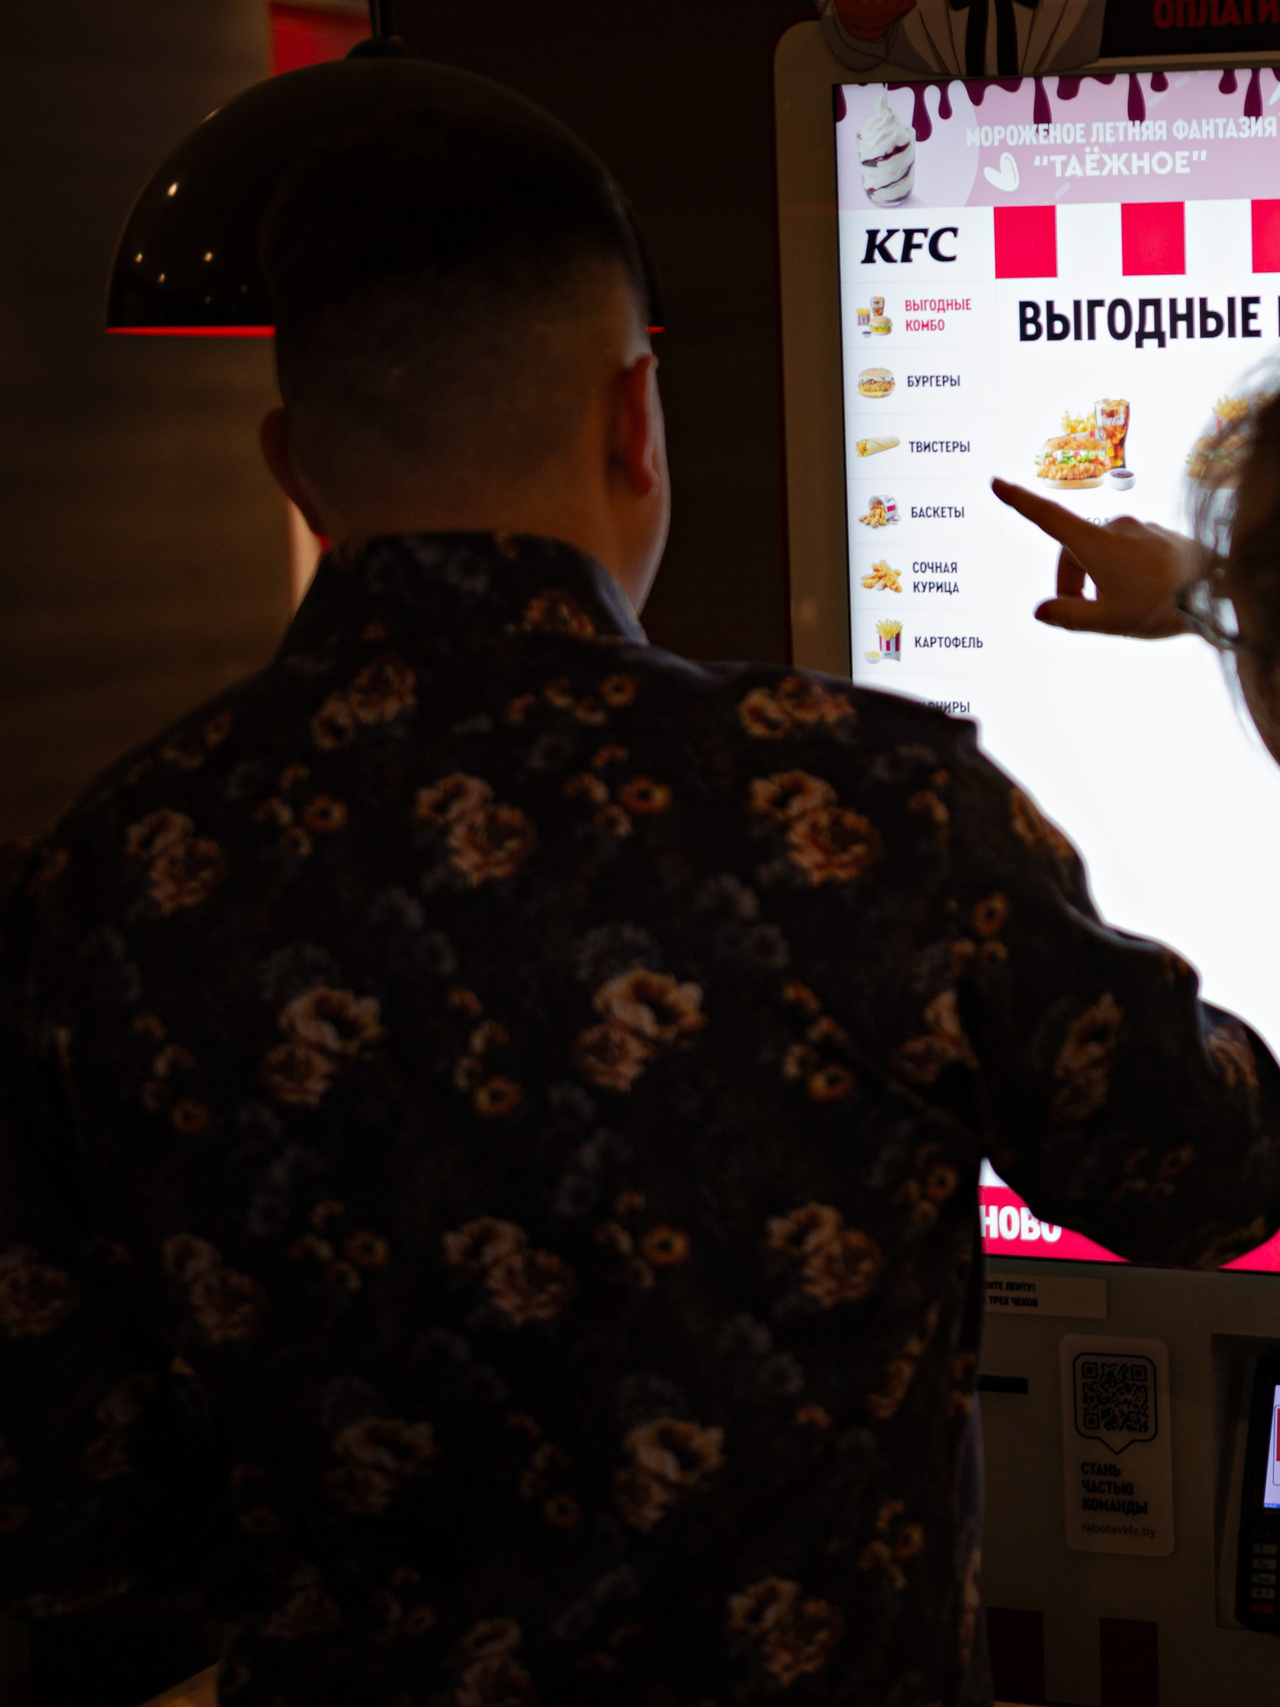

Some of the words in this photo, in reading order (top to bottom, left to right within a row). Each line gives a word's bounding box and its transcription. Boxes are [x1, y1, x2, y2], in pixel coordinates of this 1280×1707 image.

[966, 122, 1086, 147] МОРОЖЕНОЕ
[1090, 119, 1167, 144] ЛЕТНЯЯ
[1172, 116, 1278, 141] ФАНТАЗИЯ
[861, 226, 960, 265] KFC
[905, 298, 971, 313] ВЫГОДНЫЕ
[906, 319, 945, 331] КОМБО
[1018, 296, 1262, 349] ВЫГОДНЫЕ
[907, 375, 960, 387] БУРГЕРЫ
[908, 441, 970, 453] ТВИСТЕРЫ
[910, 506, 965, 519] БАСКЕТЫ
[912, 561, 958, 574] СОЧНАЯ
[913, 581, 960, 595] КУРИЦА
[914, 636, 984, 649] КАРТОФЕЛЬ
[1081, 1462, 1121, 1477] СТАНЬ
[1081, 1480, 1134, 1496] ЧАСТЬЮ
[1082, 1498, 1148, 1516] КОМАНДЫ
